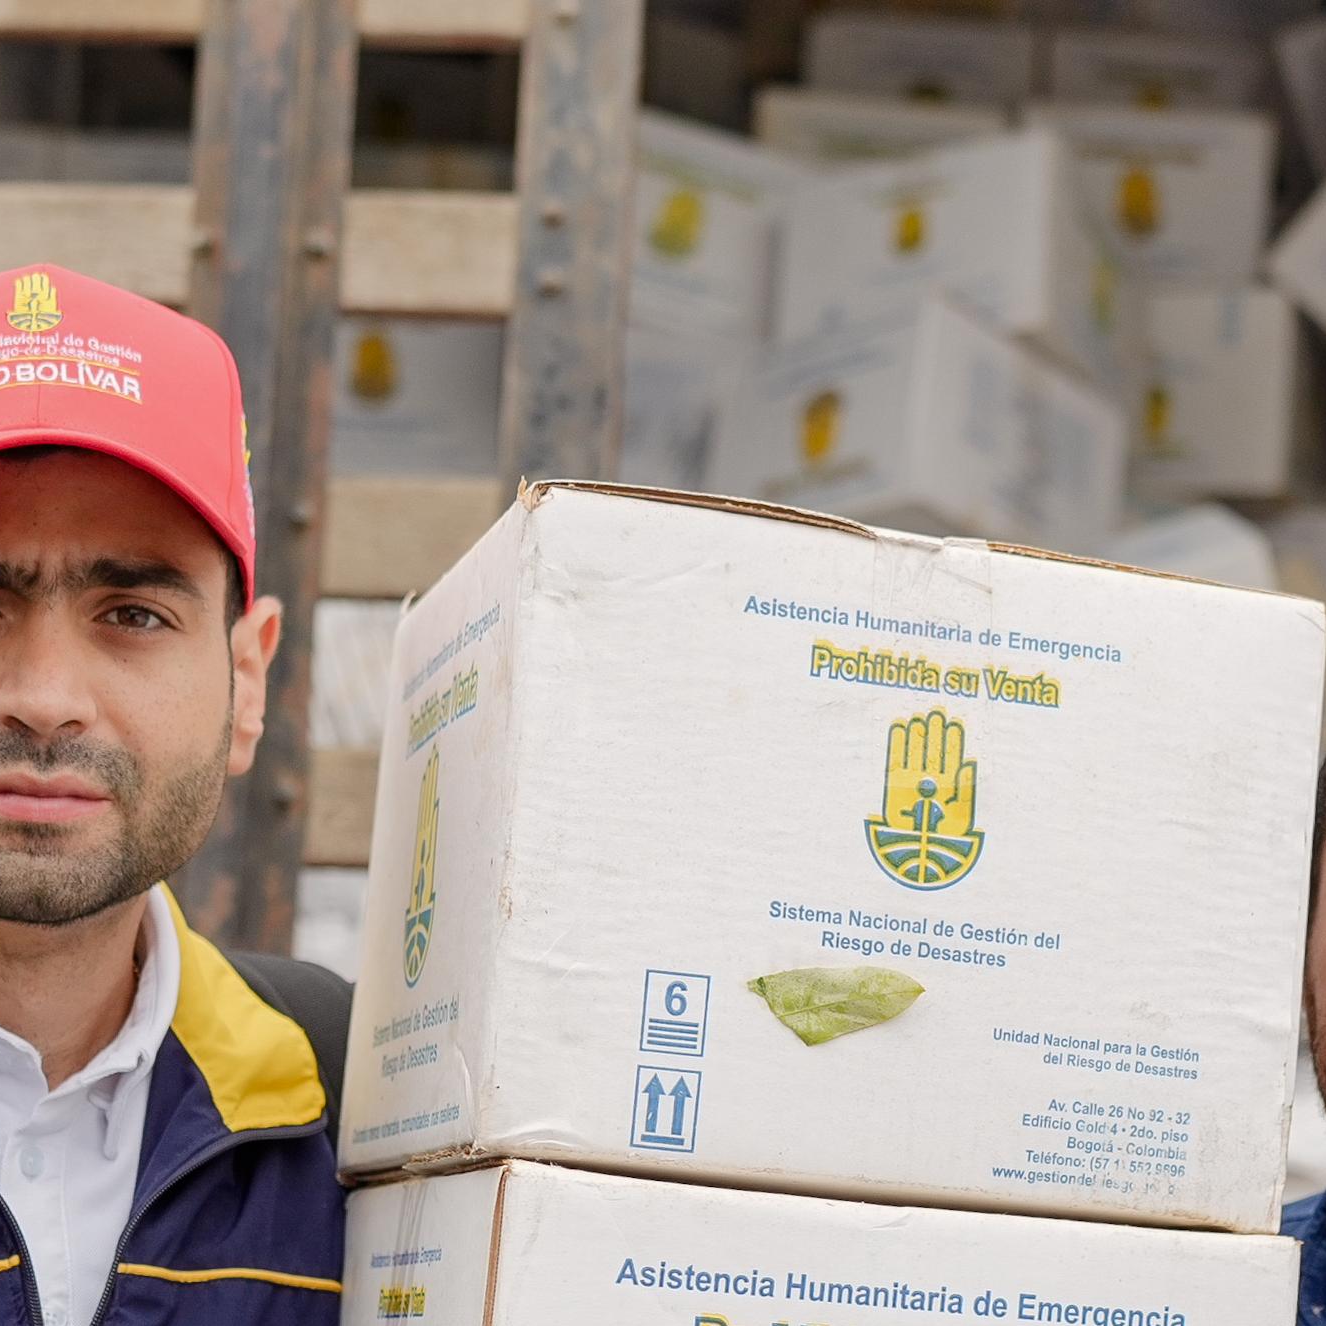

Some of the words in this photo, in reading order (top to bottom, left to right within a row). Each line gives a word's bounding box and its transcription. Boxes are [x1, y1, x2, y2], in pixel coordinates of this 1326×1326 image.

[16, 360, 143, 401] BOLÍVAR
[743, 595, 850, 626] Asistencia
[855, 609, 973, 643] Humanitaria
[978, 627, 1002, 648] de
[1008, 631, 1123, 663] Emergencia
[809, 641, 941, 694] Prohibida
[943, 666, 979, 699] su
[984, 666, 1061, 708] Venta
[768, 900, 843, 927] Sistema
[848, 909, 928, 936] Nacional
[933, 918, 955, 938] de
[959, 921, 1029, 946] Gestión
[1033, 931, 1060, 951] del
[821, 931, 885, 957] Riesgo
[889, 938, 912, 957] de
[917, 942, 1007, 968] Desastres
[663, 979, 689, 1018] 6
[993, 1028, 1040, 1045] Unidad
[1043, 1033, 1100, 1051] Nacional
[1103, 1042, 1132, 1056] para
[1136, 1043, 1147, 1057] la
[1150, 1045, 1200, 1063] Gestión
[1043, 1052, 1063, 1066] del
[1066, 1054, 1112, 1073] Riesgo
[1115, 1059, 1131, 1073] de
[1134, 1061, 1198, 1080] Desastres
[1022, 1114, 1071, 1131] Edificio
[1075, 1119, 1106, 1135] Gold
[1109, 1123, 1118, 1136] 4
[1130, 1125, 1158, 1140] 2do.
[1161, 1128, 1189, 1143] piso
[1048, 1099, 1068, 1113] Av.
[1072, 1101, 1105, 1117] Calle
[1108, 1105, 1124, 1119] 26
[1127, 1107, 1145, 1121] No
[1149, 1109, 1164, 1123] 92
[1175, 1112, 1191, 1125] 32
[1025, 1150, 1086, 1168] Teléfono:
[1067, 1136, 1114, 1154] Bogotá
[1126, 1142, 1187, 1161] Colombia
[616, 1258, 776, 1298] Asistencia
[785, 1273, 964, 1315] Humanitaria
[973, 1291, 1009, 1319] de
